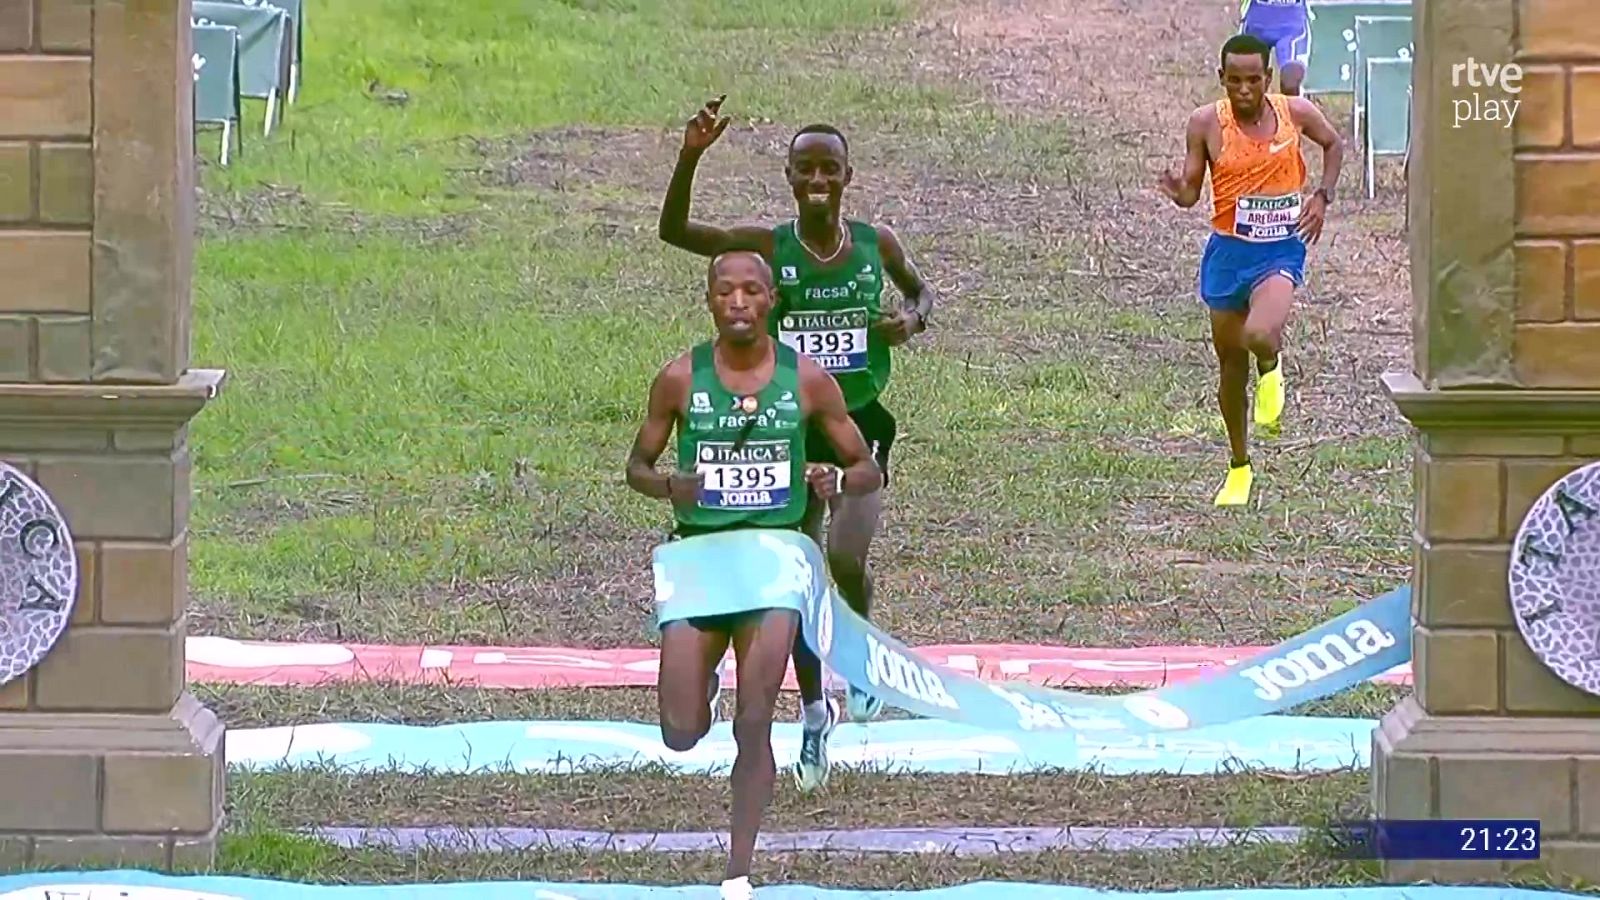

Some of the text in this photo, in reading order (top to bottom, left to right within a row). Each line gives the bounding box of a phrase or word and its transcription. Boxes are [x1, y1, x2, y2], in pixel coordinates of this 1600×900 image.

[798, 315, 850, 328] ITALICA
[796, 332, 855, 354] 1393
[811, 355, 850, 368] ma
[718, 447, 772, 461] ITALICA
[715, 466, 777, 489] 1395
[720, 490, 772, 506] Joma
[1239, 617, 1396, 701] Joma
[865, 633, 961, 710] Joma
